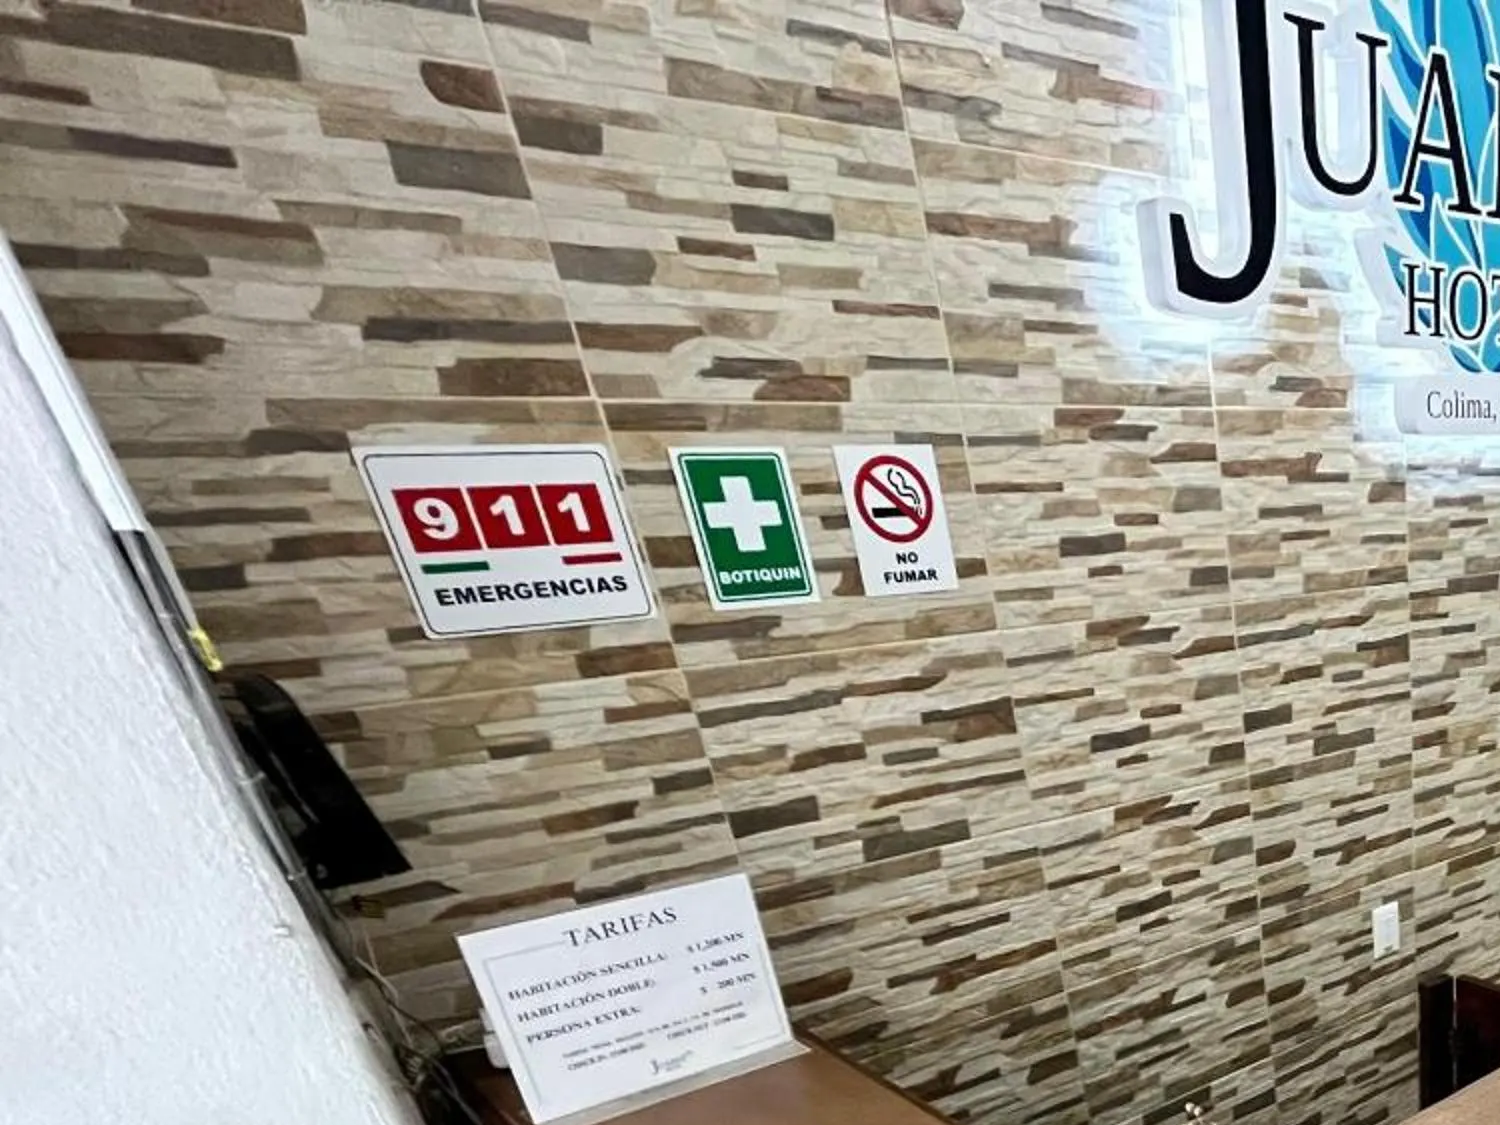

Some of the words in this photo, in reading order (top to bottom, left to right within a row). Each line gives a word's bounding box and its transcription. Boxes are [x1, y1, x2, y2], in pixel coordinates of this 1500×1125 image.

[1427, 389, 1497, 423] Colima,
[896, 551, 920, 567] NO
[719, 566, 802, 587] BOTIQUIN
[883, 567, 939, 587] FUMAR
[434, 575, 629, 607] EMERGENCIAS
[562, 905, 678, 948] TARIFAS
[526, 1020, 593, 1044] PERSONA
